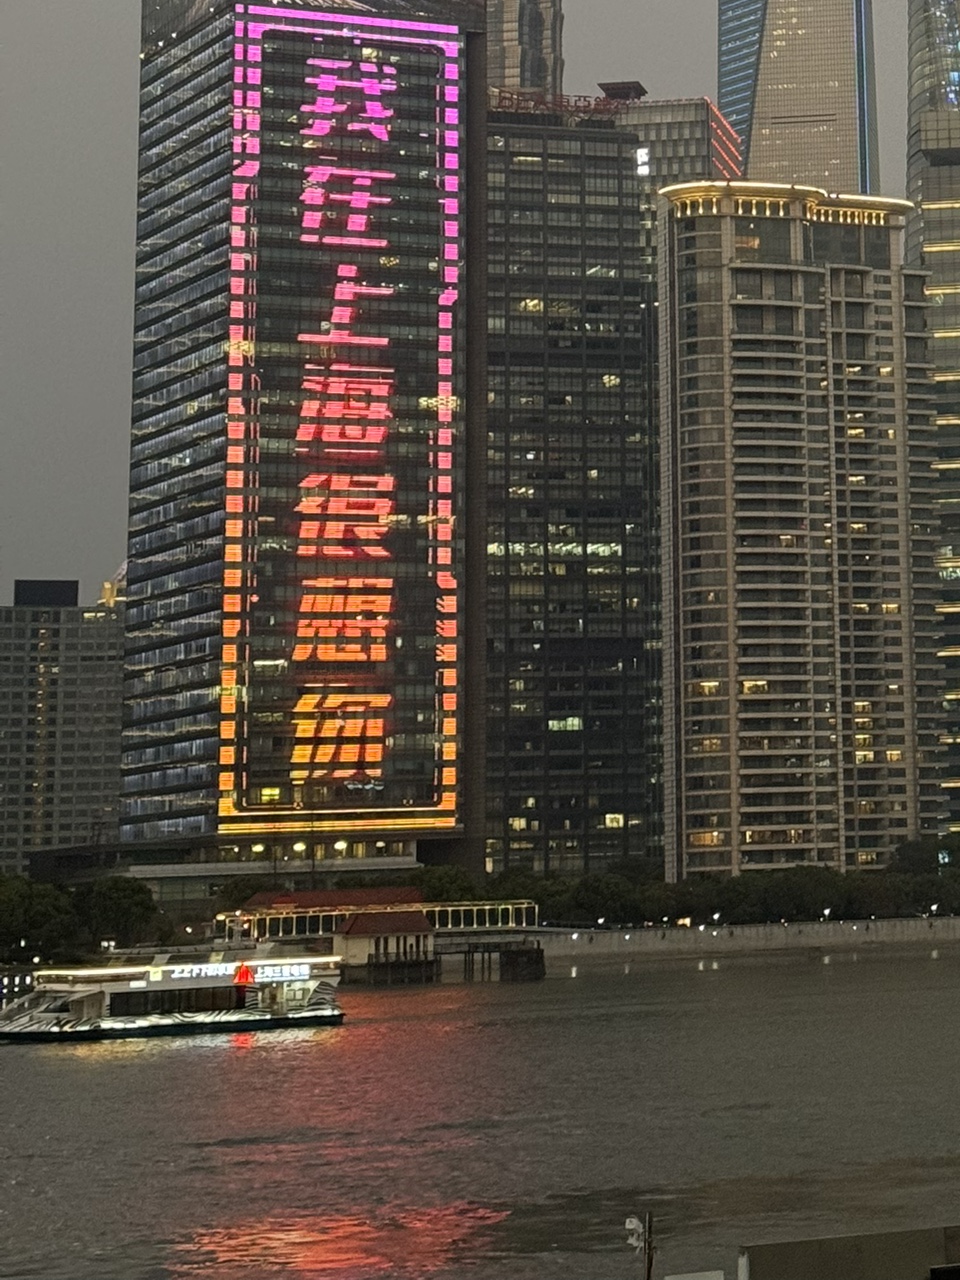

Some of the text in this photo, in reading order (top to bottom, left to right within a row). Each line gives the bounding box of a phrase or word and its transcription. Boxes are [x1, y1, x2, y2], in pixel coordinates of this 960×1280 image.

[291, 57, 396, 780] 我在上海很想你
